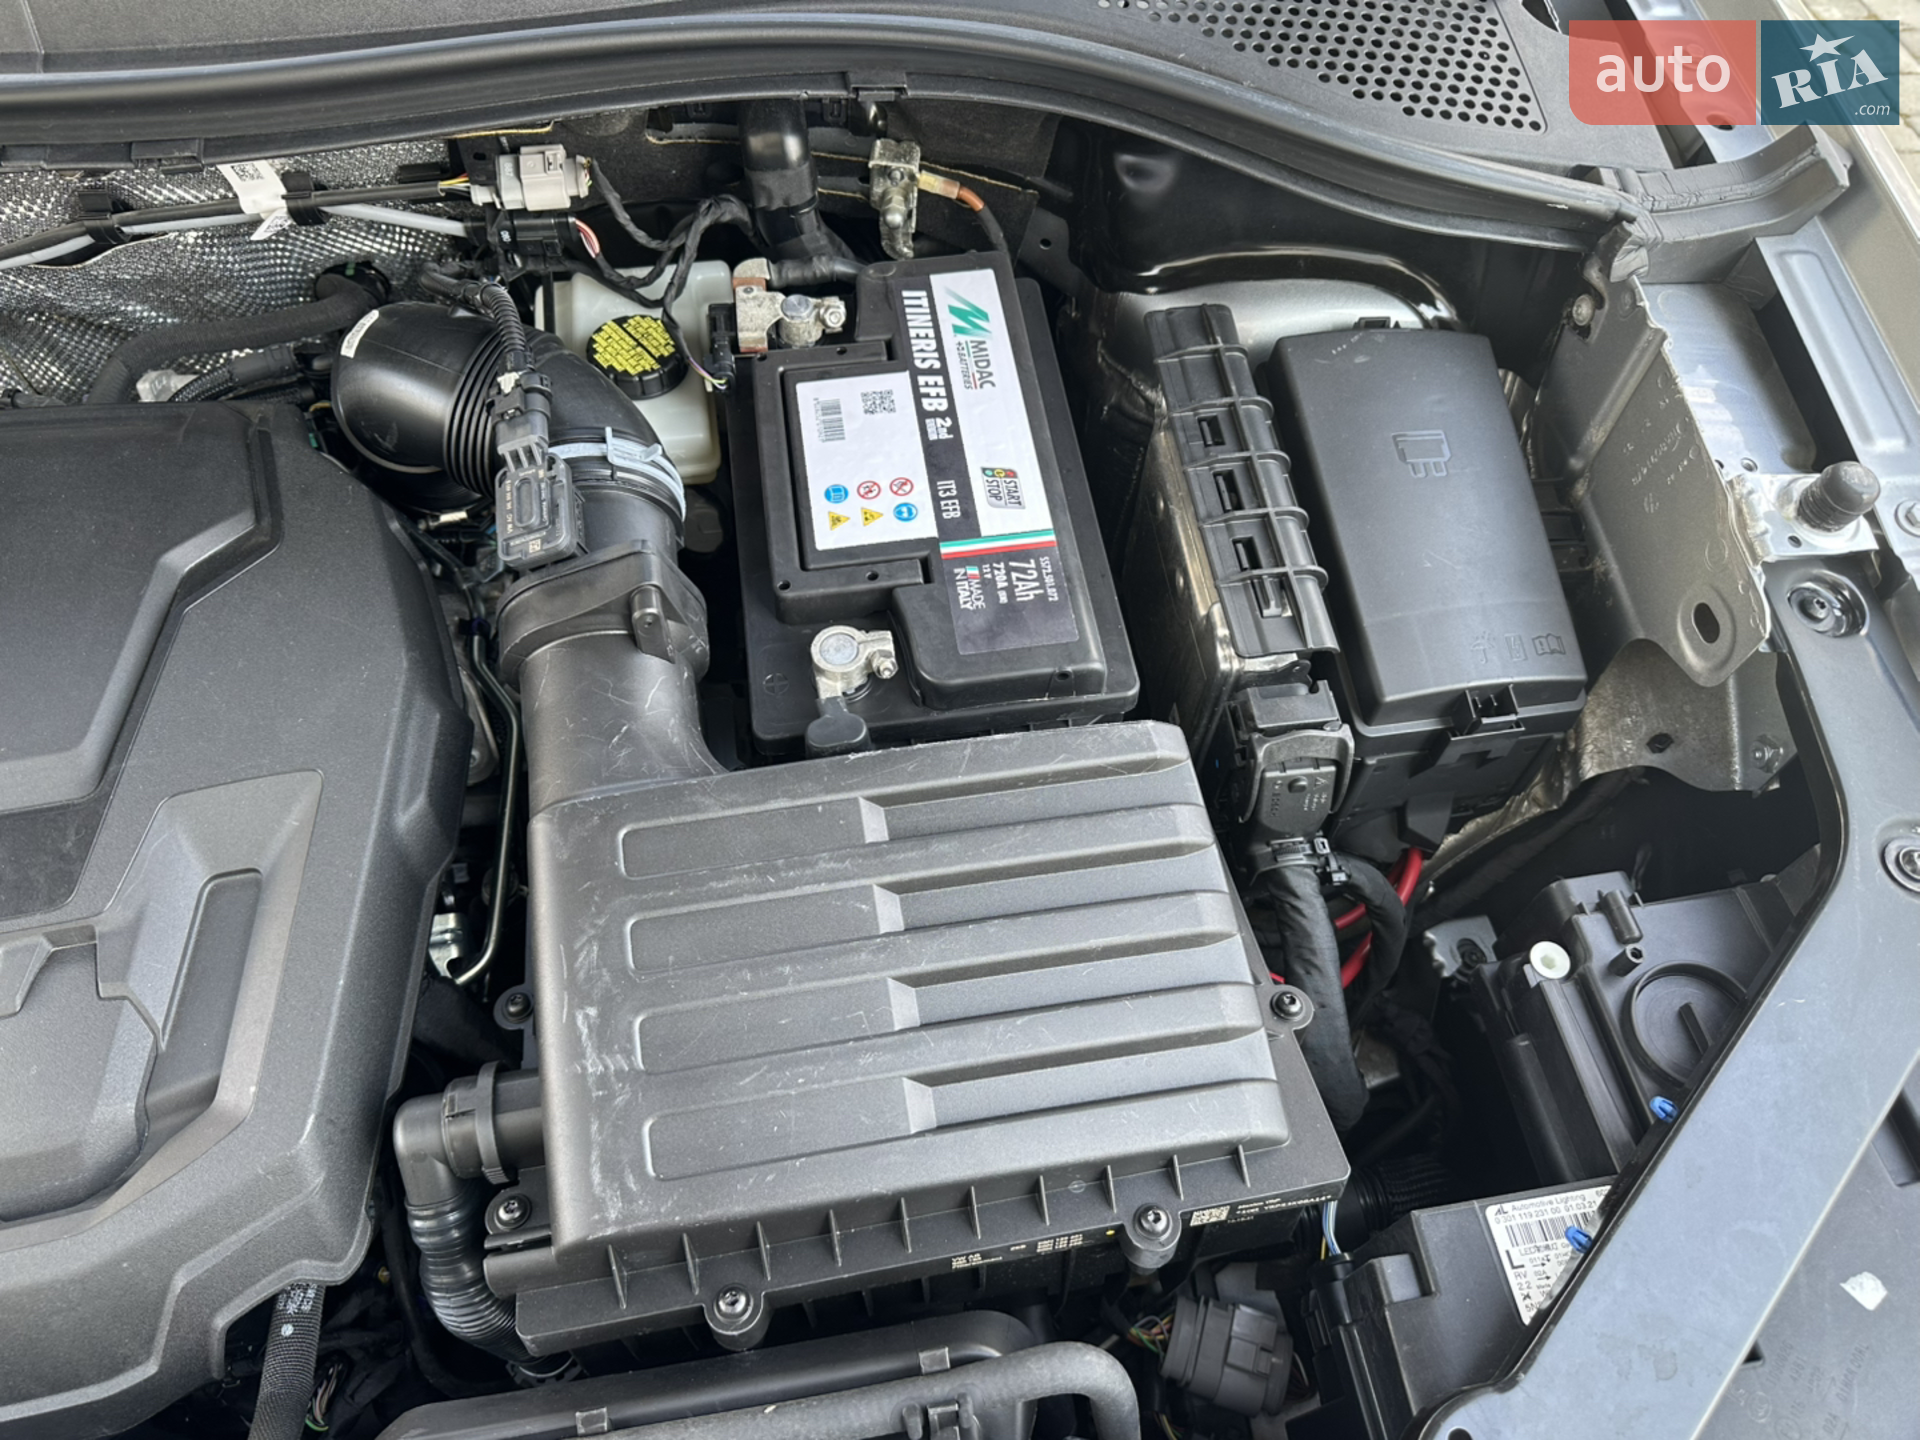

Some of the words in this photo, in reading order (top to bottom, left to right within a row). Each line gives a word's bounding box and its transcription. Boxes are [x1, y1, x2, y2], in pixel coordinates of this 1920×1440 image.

[902, 290, 941, 369] ITINERIS
[970, 340, 996, 390] MIDAC
[917, 375, 949, 412] EFB
[936, 416, 954, 440] 2nd
[986, 479, 1003, 502] STOP
[1003, 479, 1022, 507] START
[940, 499, 961, 519] EFB
[993, 562, 1008, 591] 720A
[1008, 558, 1045, 601] 72Ah
[956, 580, 974, 610] ITALY
[968, 578, 986, 610] MADE
[1511, 1199, 1554, 1212] Automotive
[1555, 1194, 1586, 1206] Lighting
[1519, 1212, 1533, 1221] 119
[1535, 1209, 1549, 1218] 231
[1505, 1249, 1525, 1270] L
[1513, 1270, 1528, 1280] RV
